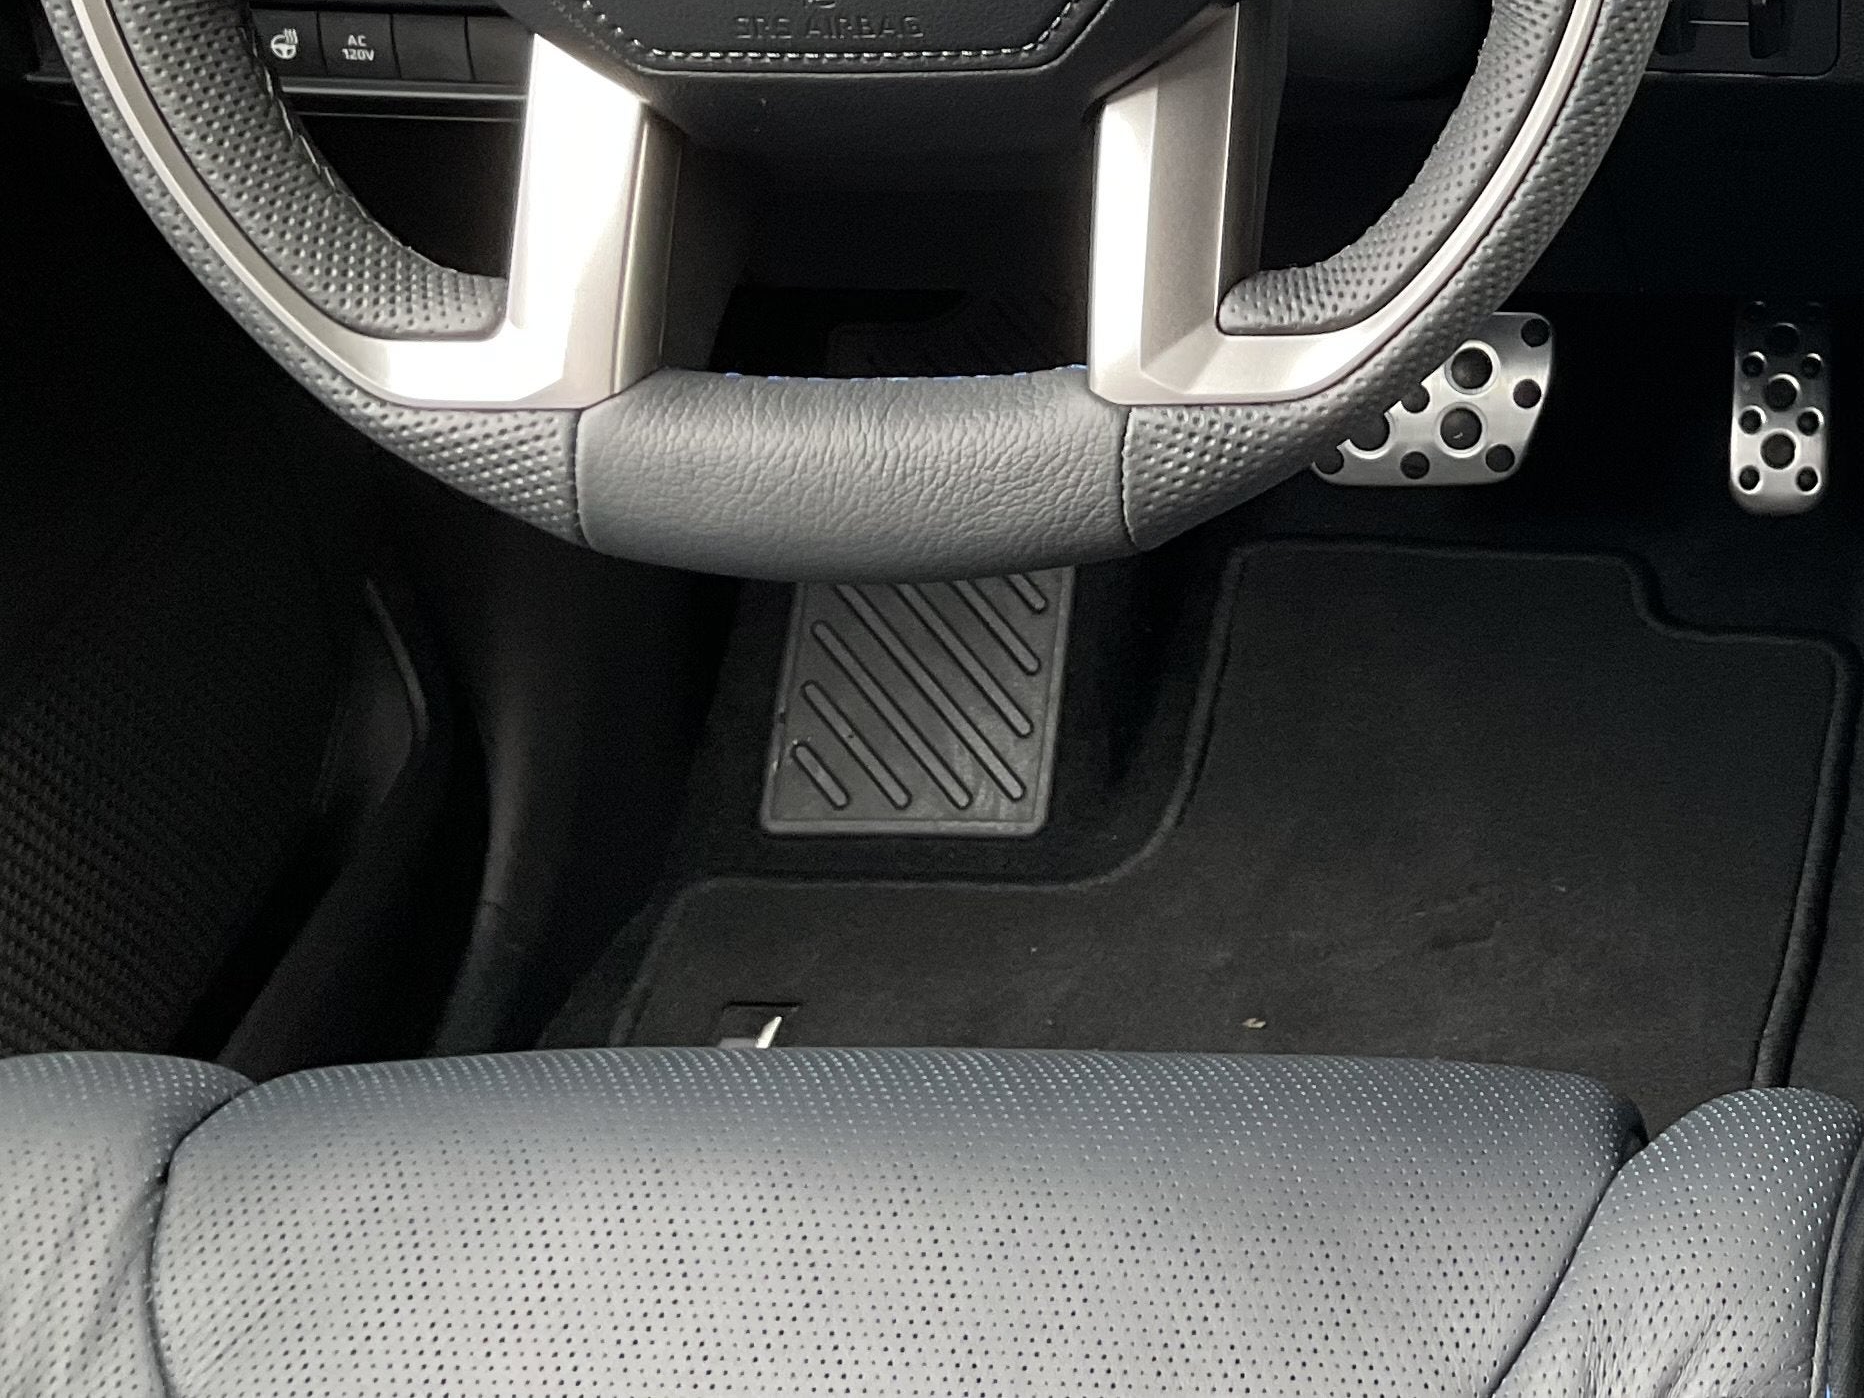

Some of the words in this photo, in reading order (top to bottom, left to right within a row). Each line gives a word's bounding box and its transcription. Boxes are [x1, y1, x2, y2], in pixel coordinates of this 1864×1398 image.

[804, 16, 924, 39] AIRBAG
[347, 34, 368, 47] AC
[341, 48, 375, 62] 120V
